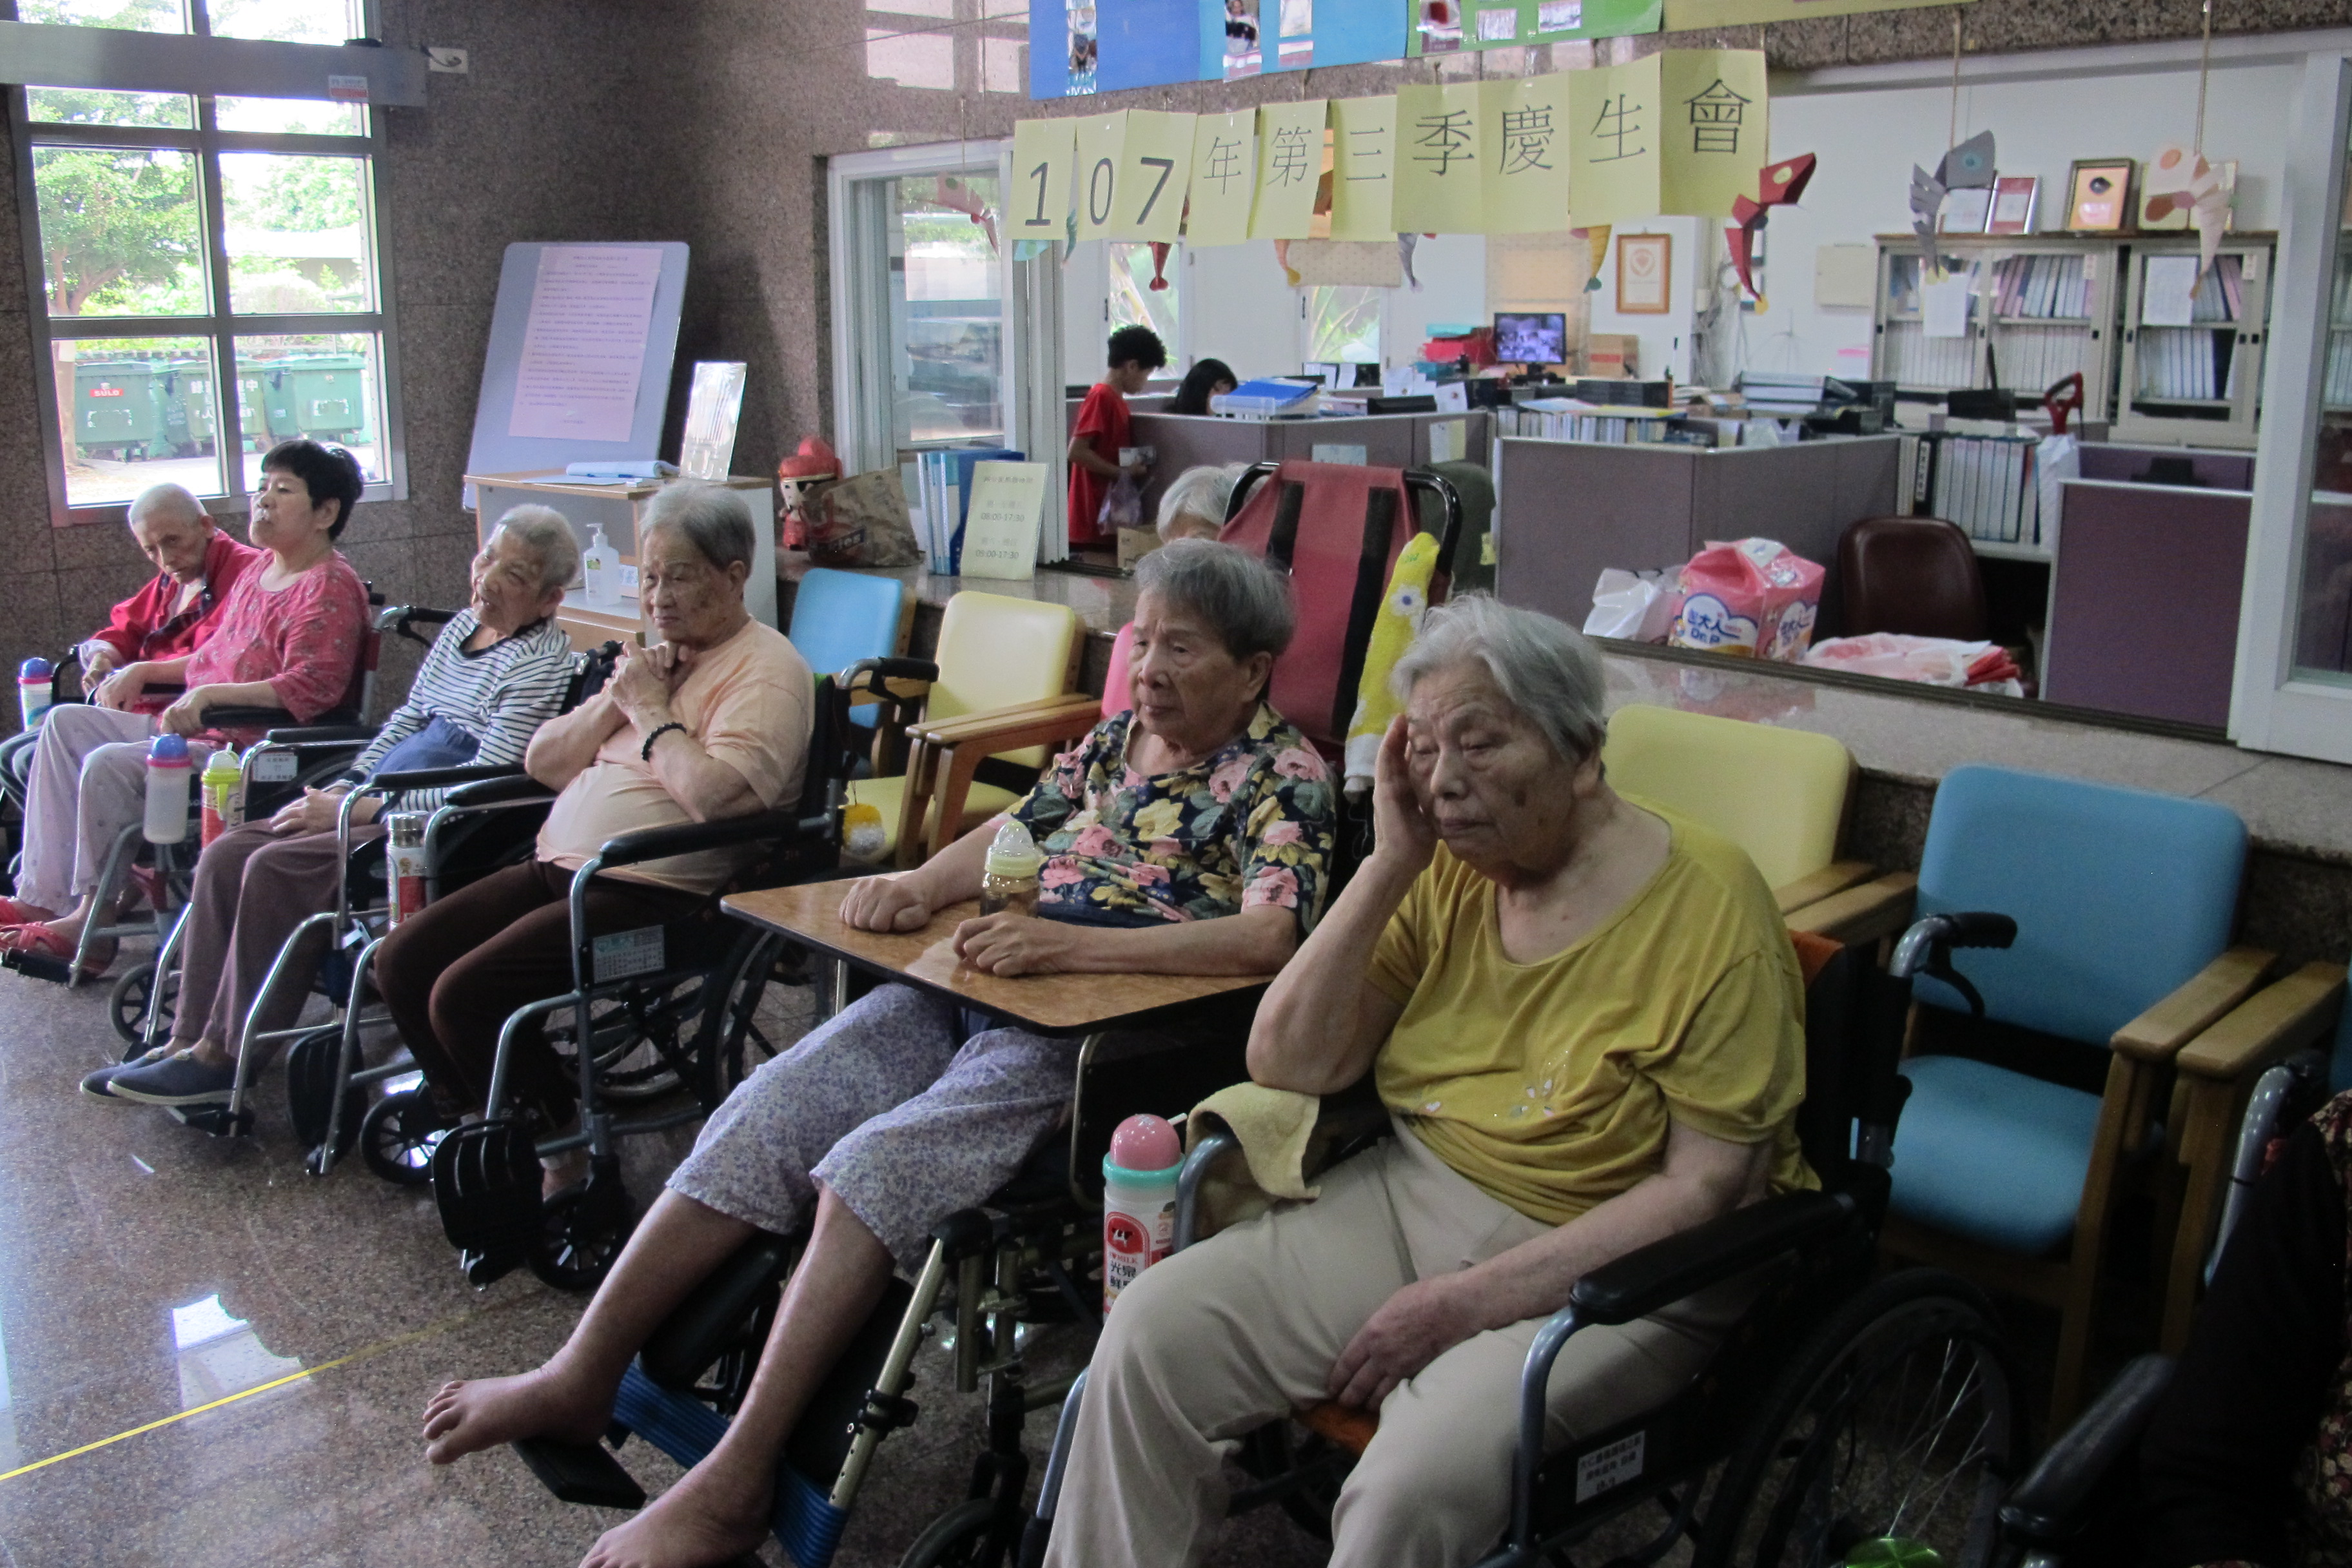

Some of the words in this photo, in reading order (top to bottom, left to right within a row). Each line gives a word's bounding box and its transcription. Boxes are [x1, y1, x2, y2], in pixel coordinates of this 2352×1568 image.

[1024, 79, 1752, 227] 107年第三季慶生會
